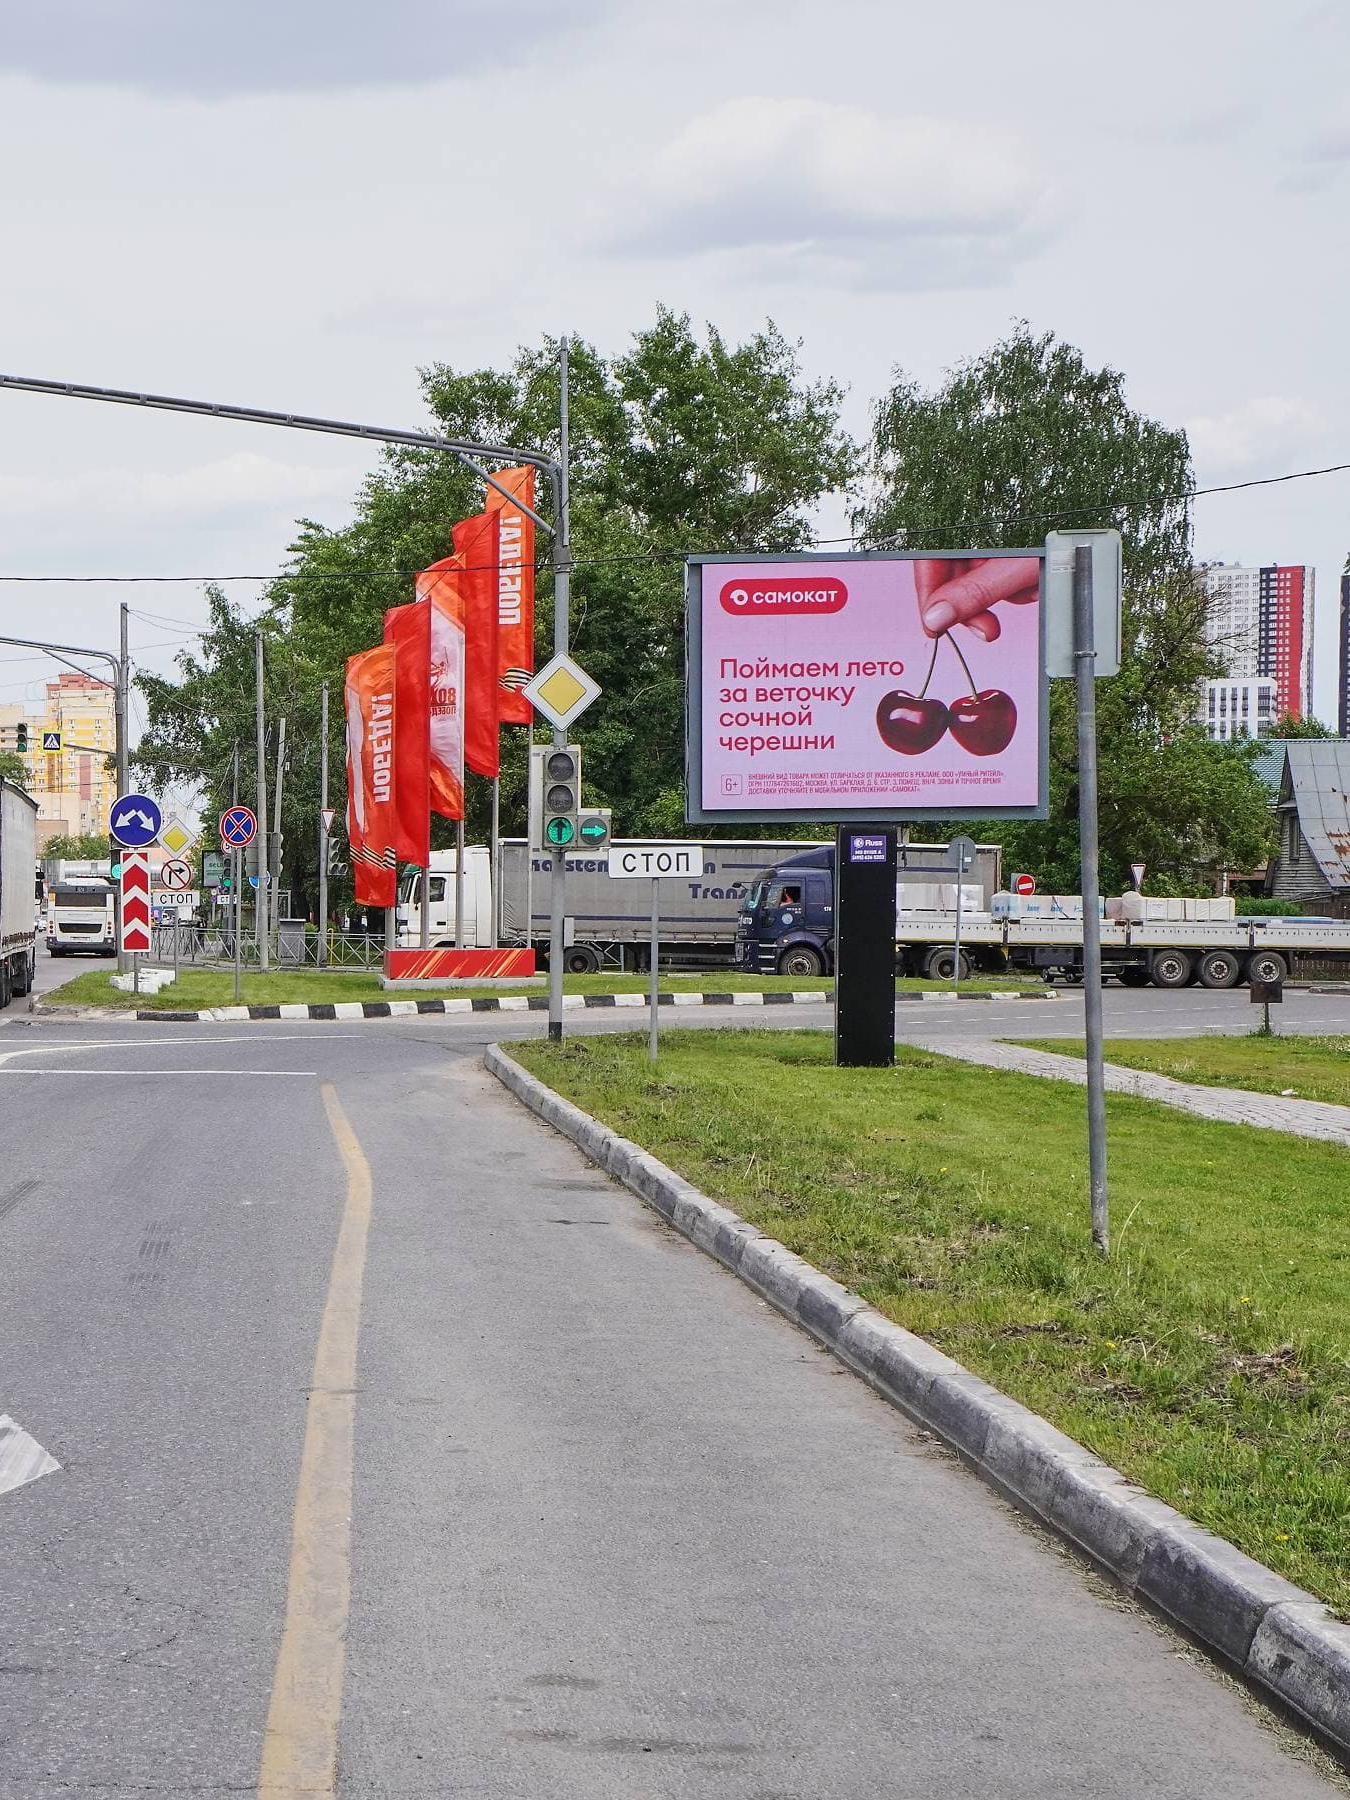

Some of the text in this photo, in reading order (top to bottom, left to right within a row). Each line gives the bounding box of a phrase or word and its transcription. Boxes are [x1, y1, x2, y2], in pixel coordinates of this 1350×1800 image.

[752, 590, 838, 604] самокат
[720, 656, 904, 678] Поймаем лето
[719, 686, 856, 706] за веточку
[719, 704, 812, 727] сочной
[719, 735, 835, 756] черешни
[725, 777, 738, 792] 6+
[622, 852, 690, 873] СТОП
[160, 893, 193, 904] СТОП
